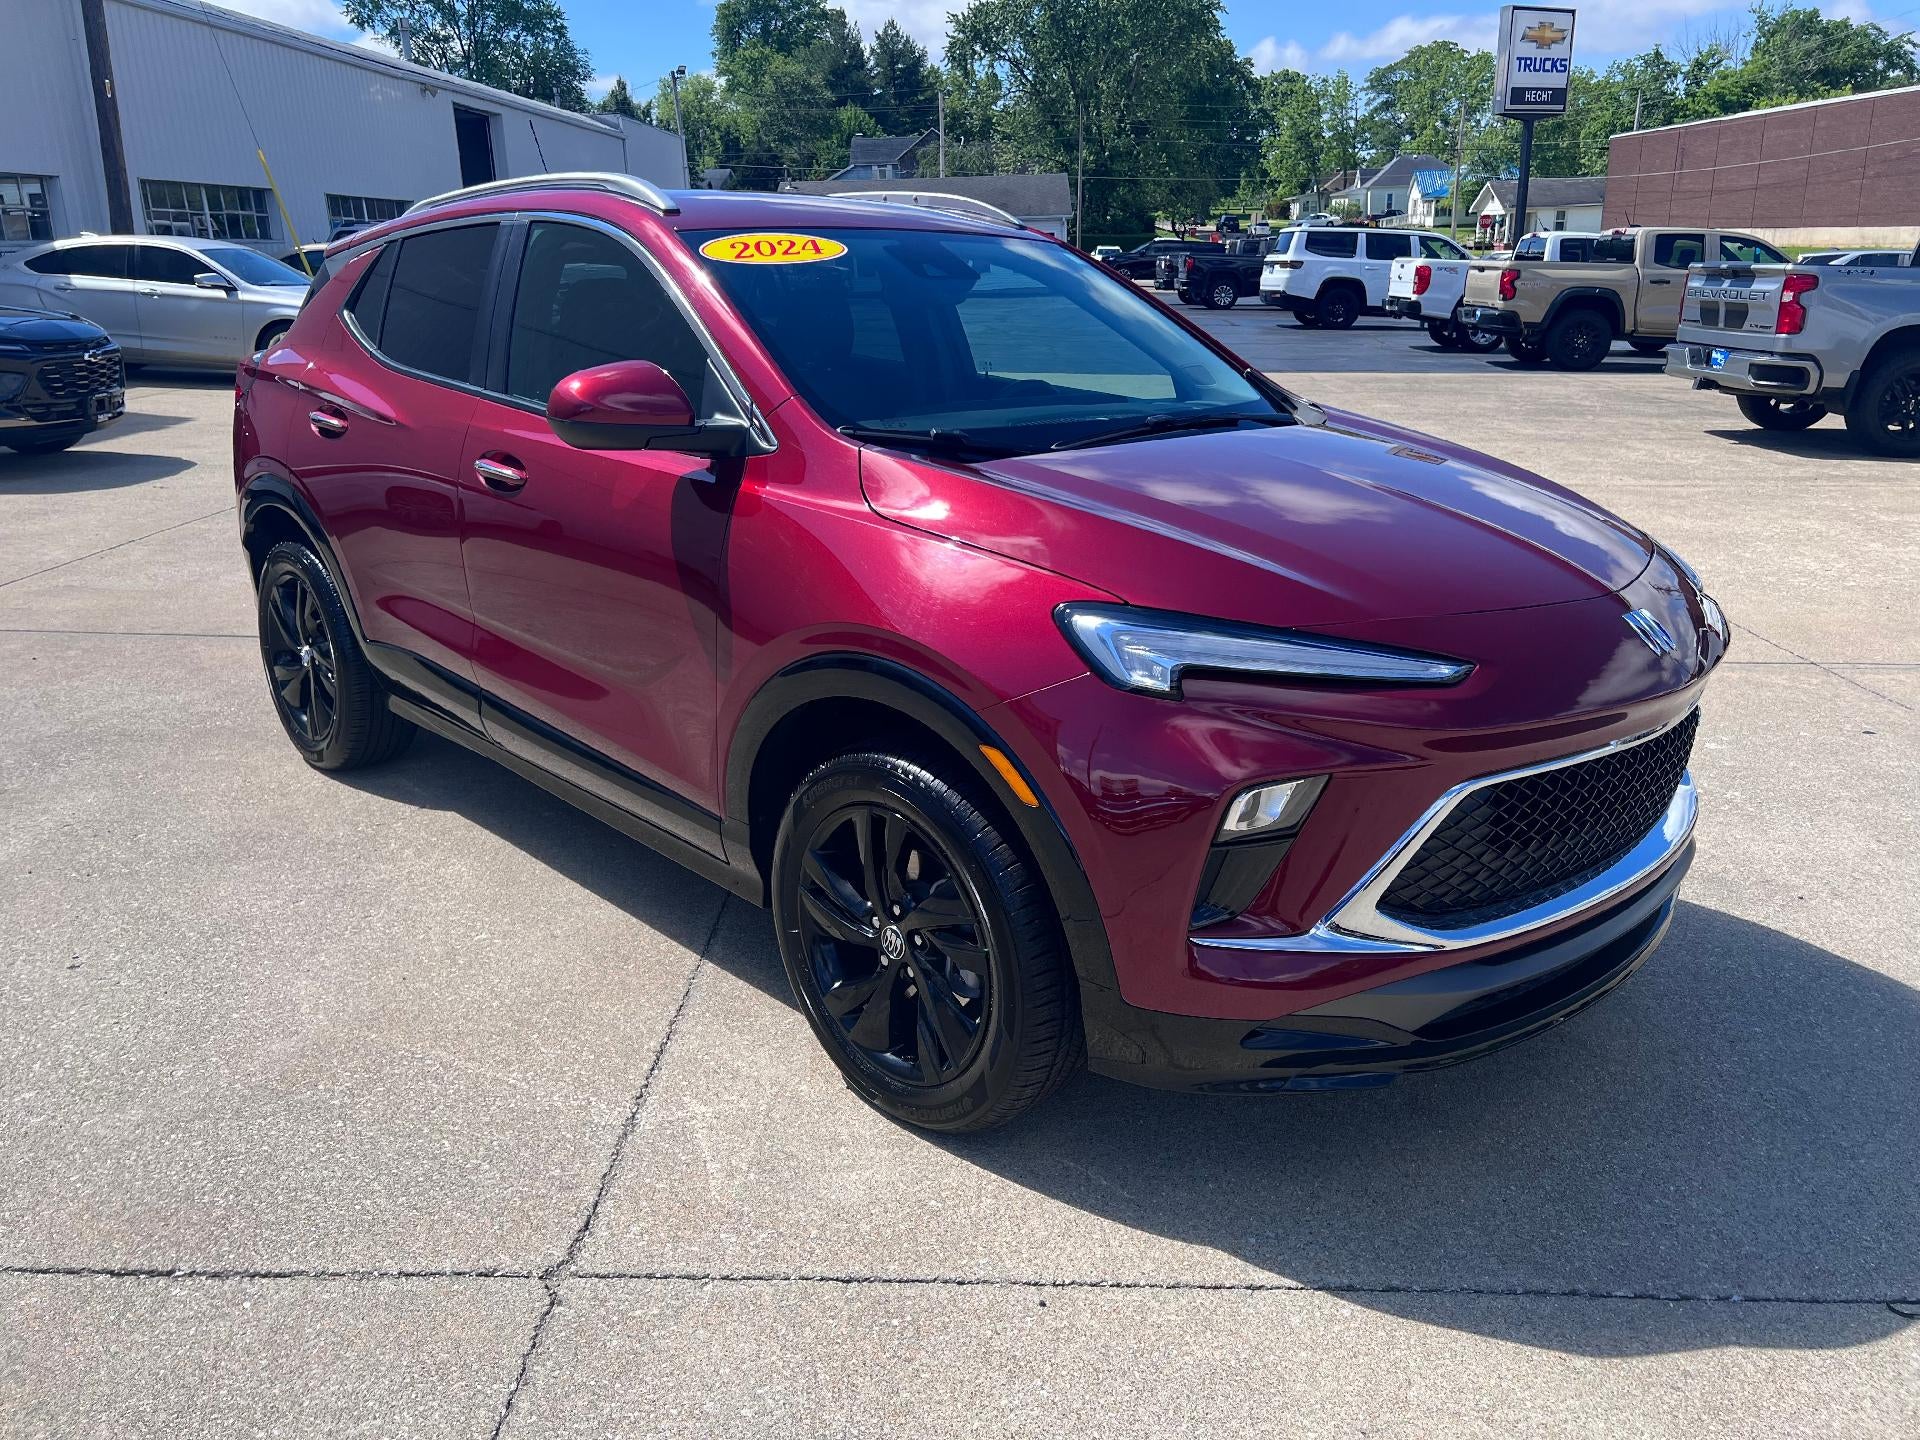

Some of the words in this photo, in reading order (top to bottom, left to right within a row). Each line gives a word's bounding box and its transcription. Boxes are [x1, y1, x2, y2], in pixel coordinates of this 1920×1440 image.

[1516, 56, 1568, 73] TRUCKS
[1525, 90, 1552, 102] HECHT
[729, 239, 824, 259] 2024
[1687, 288, 1770, 301] CHEVROLET
